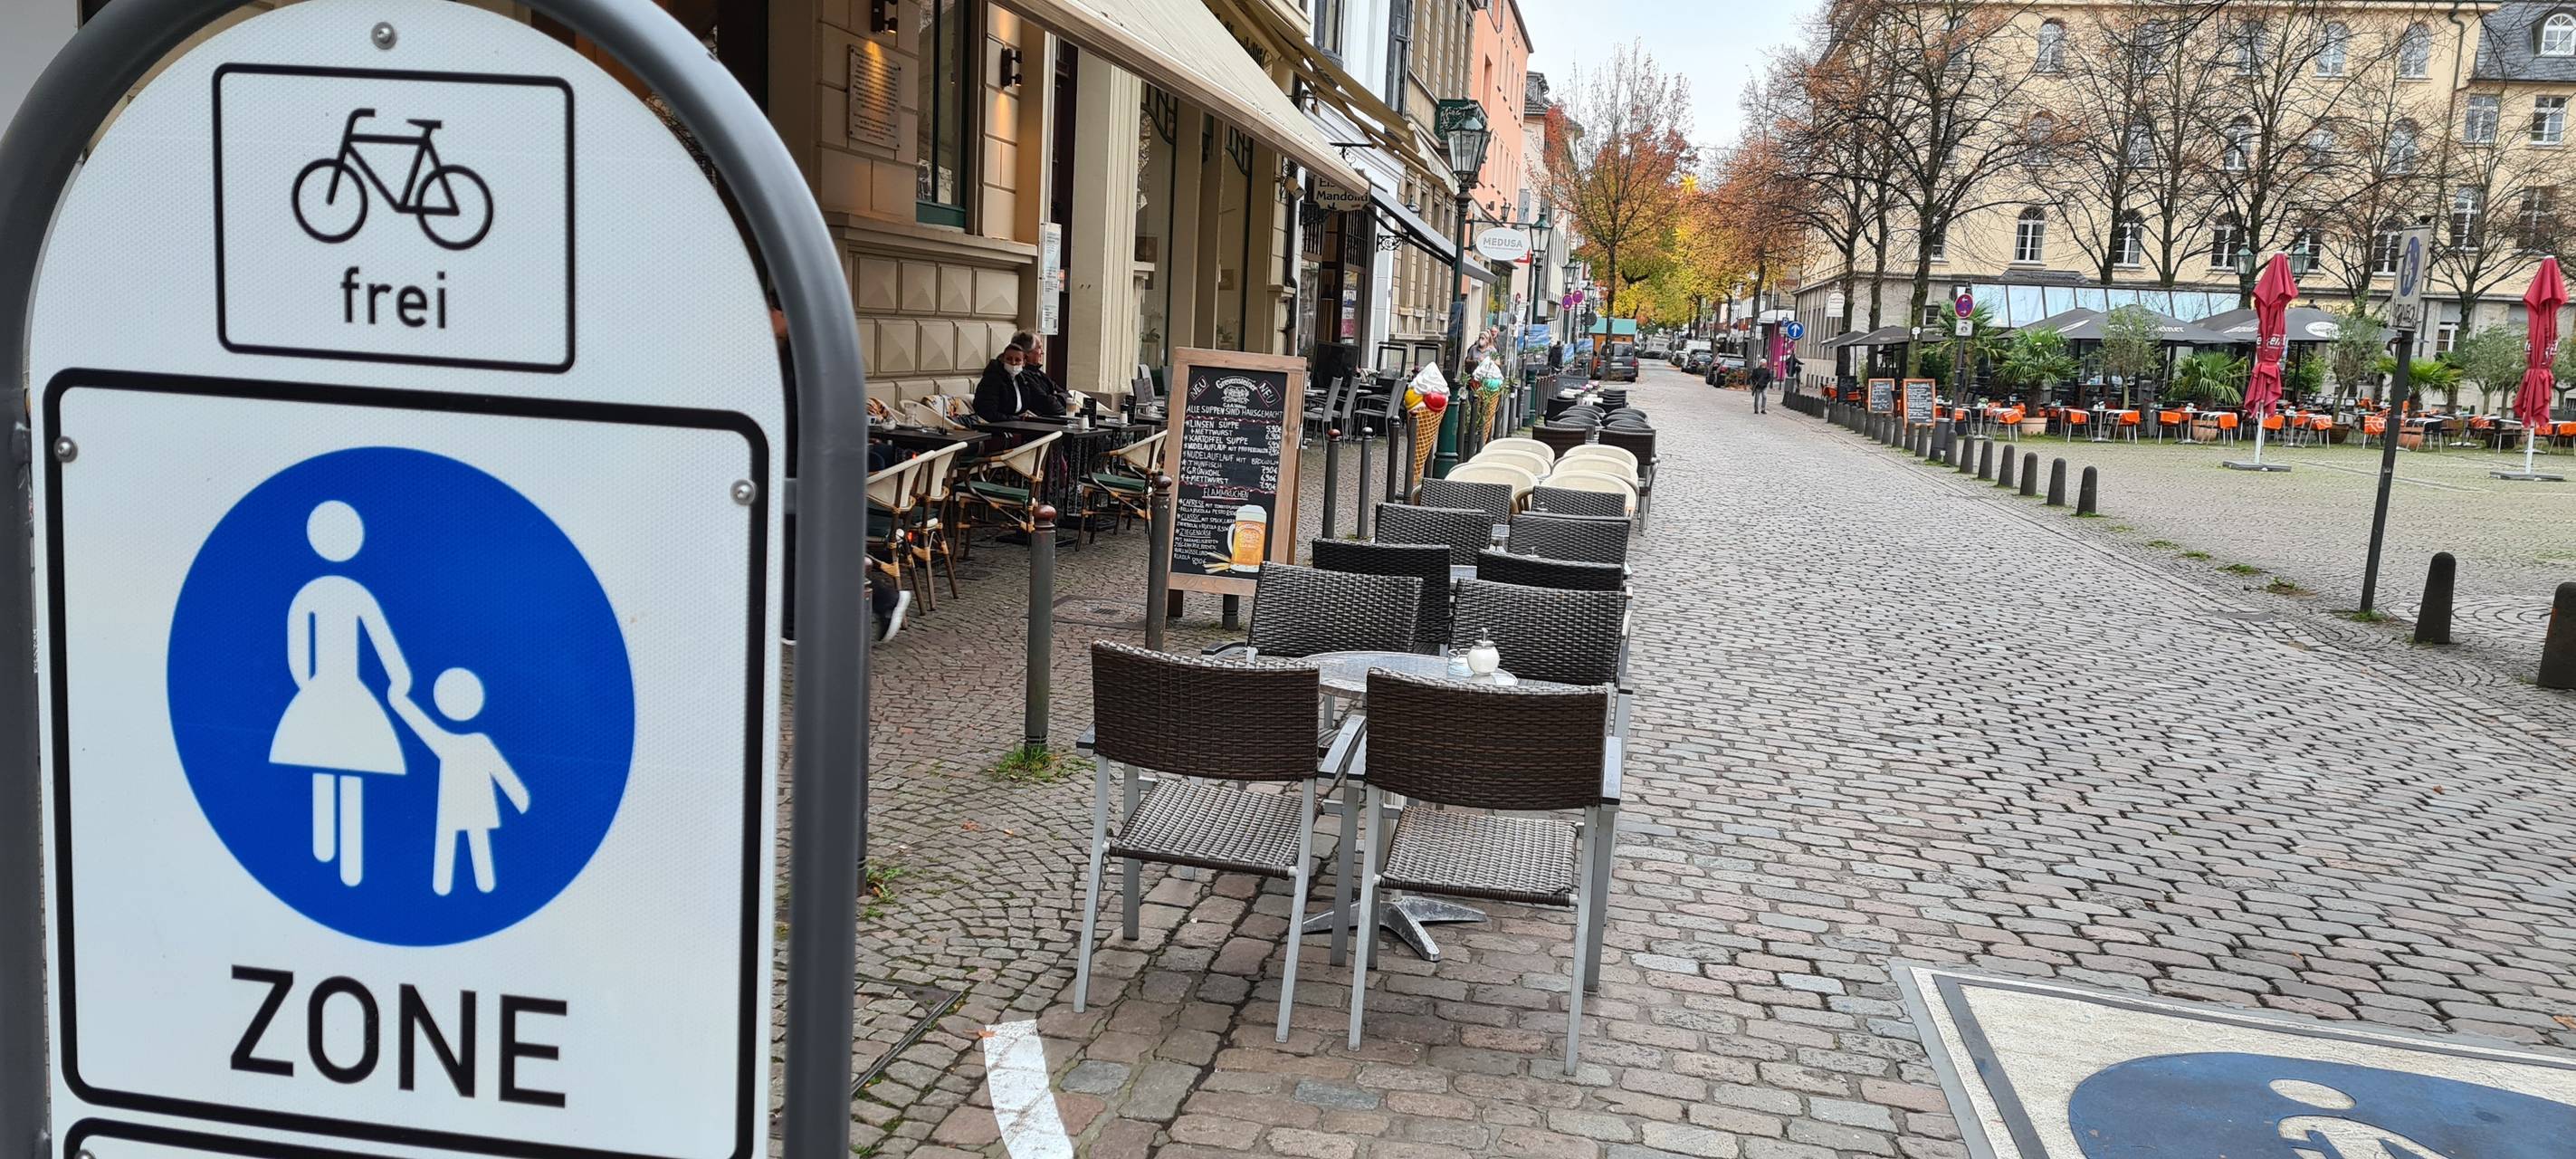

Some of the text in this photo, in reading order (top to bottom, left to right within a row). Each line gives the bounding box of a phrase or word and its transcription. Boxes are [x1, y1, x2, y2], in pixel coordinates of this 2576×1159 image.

[1483, 237, 1522, 248] MEDUSA
[339, 265, 448, 330] frei
[1189, 378, 1207, 398] NEU
[1258, 382, 1277, 405] NEU
[1186, 405, 1200, 414] ALLE
[1201, 406, 1225, 416] SUPPEN
[1225, 407, 1240, 416] SIND
[1242, 408, 1283, 419] HAUSGEMACHT
[1218, 421, 1239, 429] SUPPE
[1226, 436, 1249, 445] SUPPE
[1203, 487, 1249, 498] FLAMMKUCHEN
[228, 964, 569, 1108] ZONE
